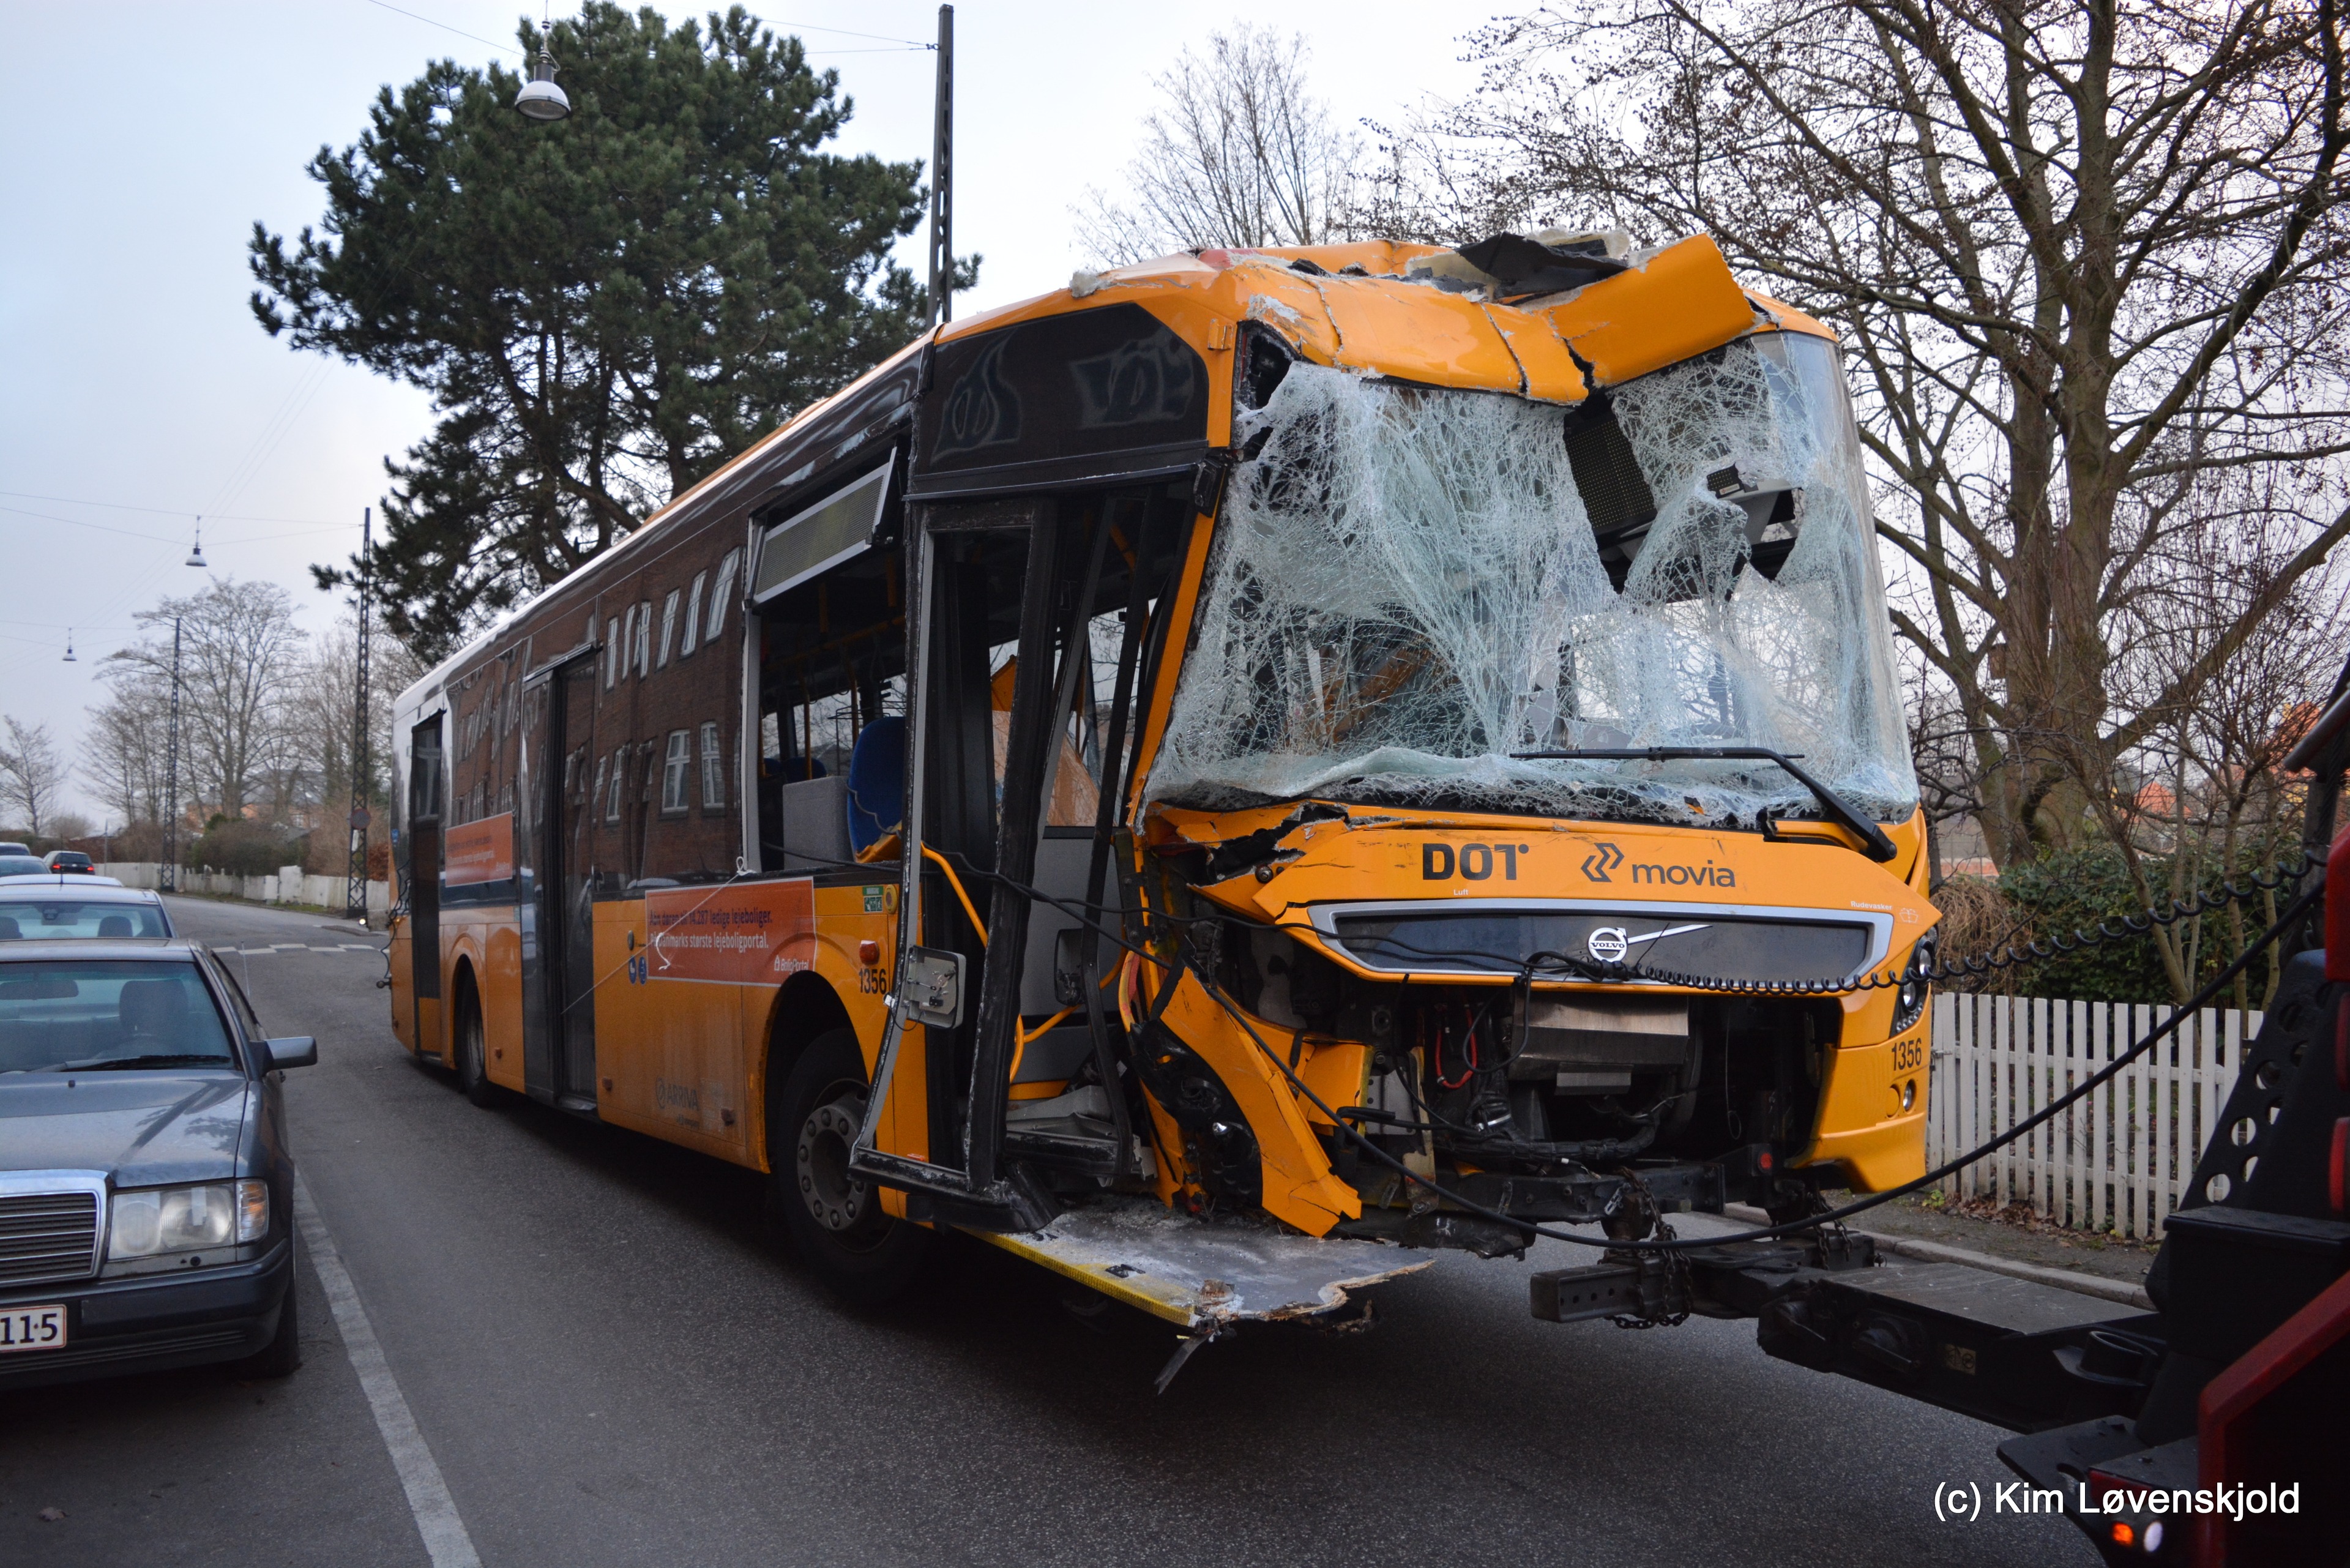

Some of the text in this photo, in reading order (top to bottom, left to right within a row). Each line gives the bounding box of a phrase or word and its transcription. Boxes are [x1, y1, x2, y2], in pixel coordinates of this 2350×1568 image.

[1422, 843, 1518, 881] DOT
[1632, 859, 1736, 887] movia
[1850, 901, 1893, 911] Rudevasker
[690, 934, 712, 948] største
[713, 931, 769, 953] lejeboligportal.
[859, 968, 887, 995] 1356
[1892, 1037, 1922, 1071] 1356
[0, 1313, 58, 1345] 115
